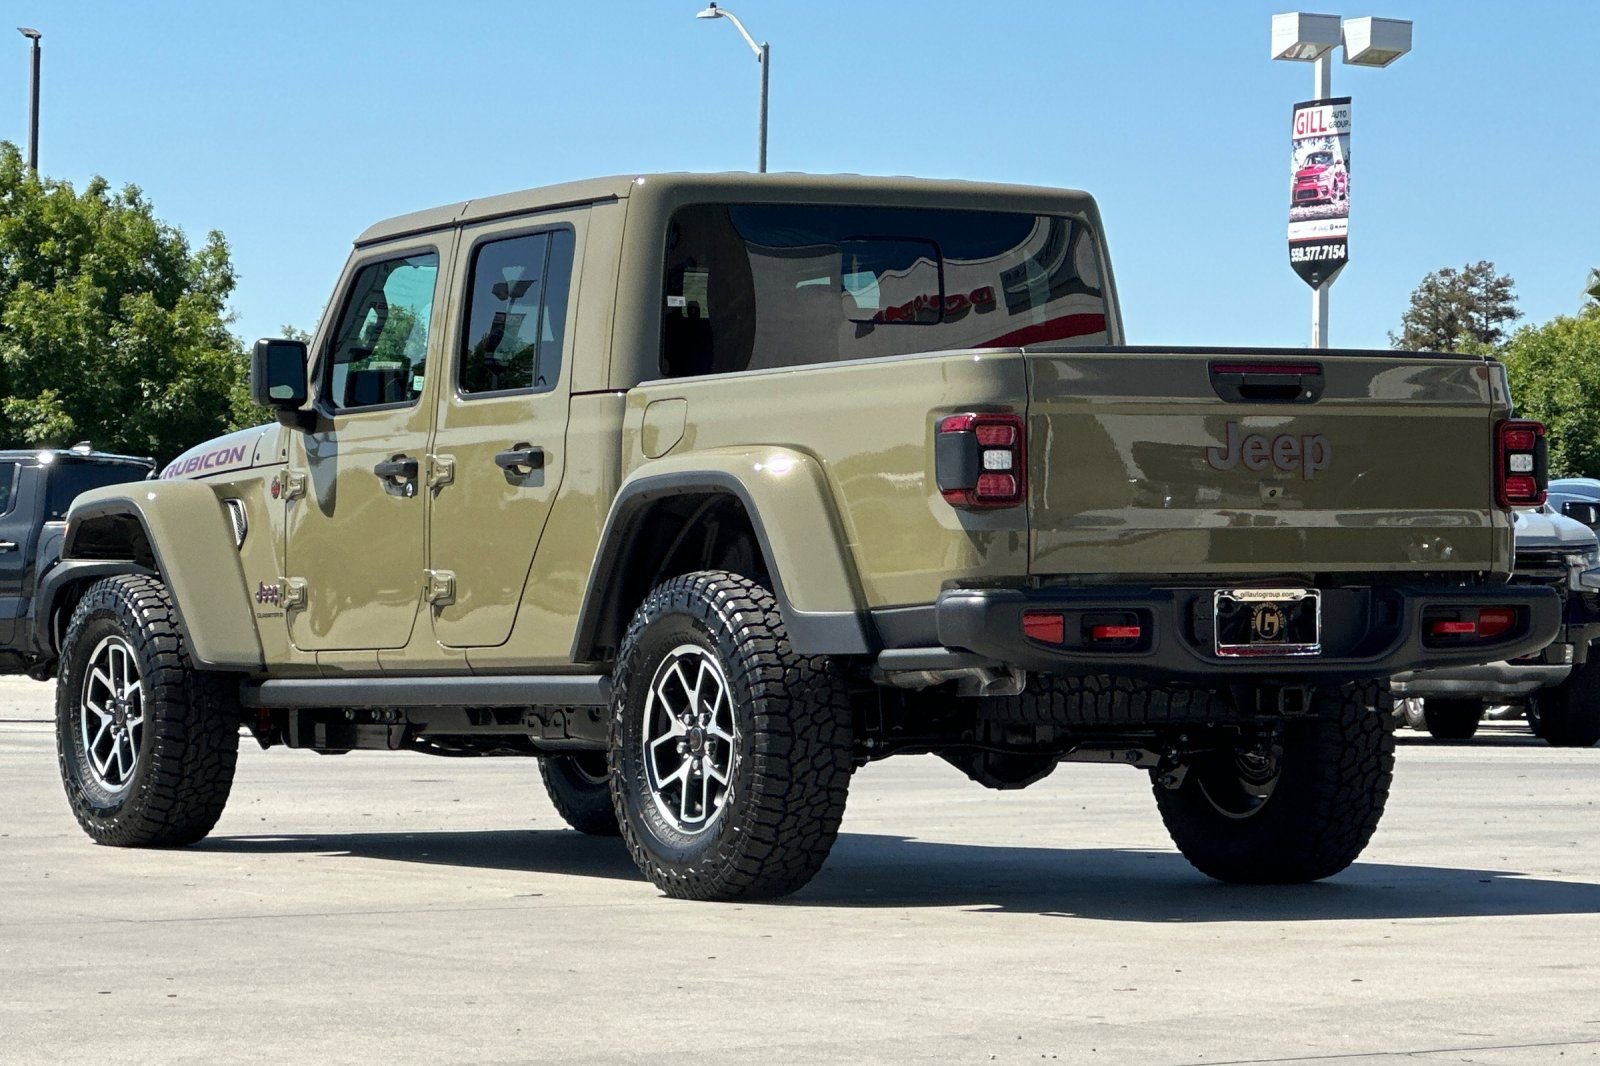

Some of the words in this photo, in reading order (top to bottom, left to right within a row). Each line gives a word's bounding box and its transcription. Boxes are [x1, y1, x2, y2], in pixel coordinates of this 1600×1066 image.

[1296, 110, 1327, 135] GILL
[1332, 110, 1347, 119] AUTO
[1328, 120, 1350, 128] GROUP
[1206, 420, 1332, 480] Jeep
[163, 445, 247, 479] RUBICON
[1240, 591, 1295, 599] gillautogroup.com
